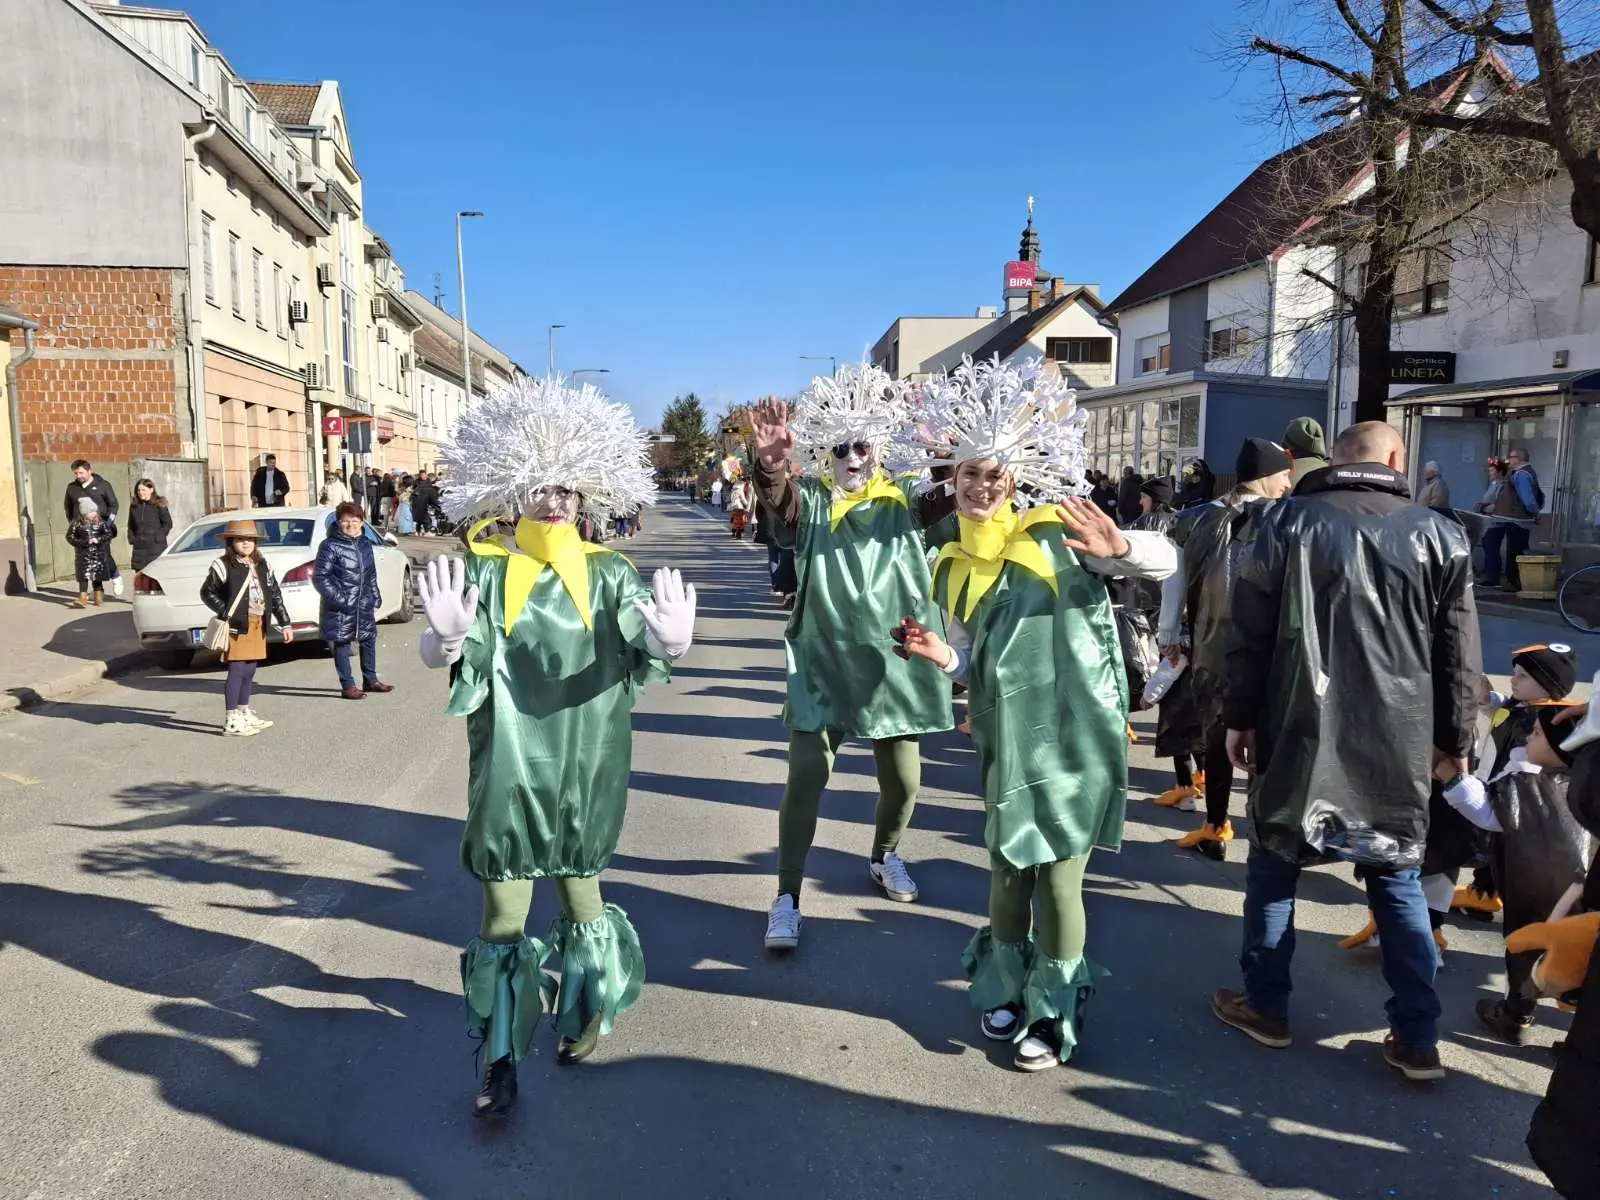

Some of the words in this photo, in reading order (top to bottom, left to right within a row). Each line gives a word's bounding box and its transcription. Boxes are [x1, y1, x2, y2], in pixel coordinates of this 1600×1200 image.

[1009, 278, 1033, 287] BIPA
[1404, 357, 1447, 365] Optika
[1391, 367, 1446, 378] LINETA
[1363, 472, 1395, 482] HANSEN
